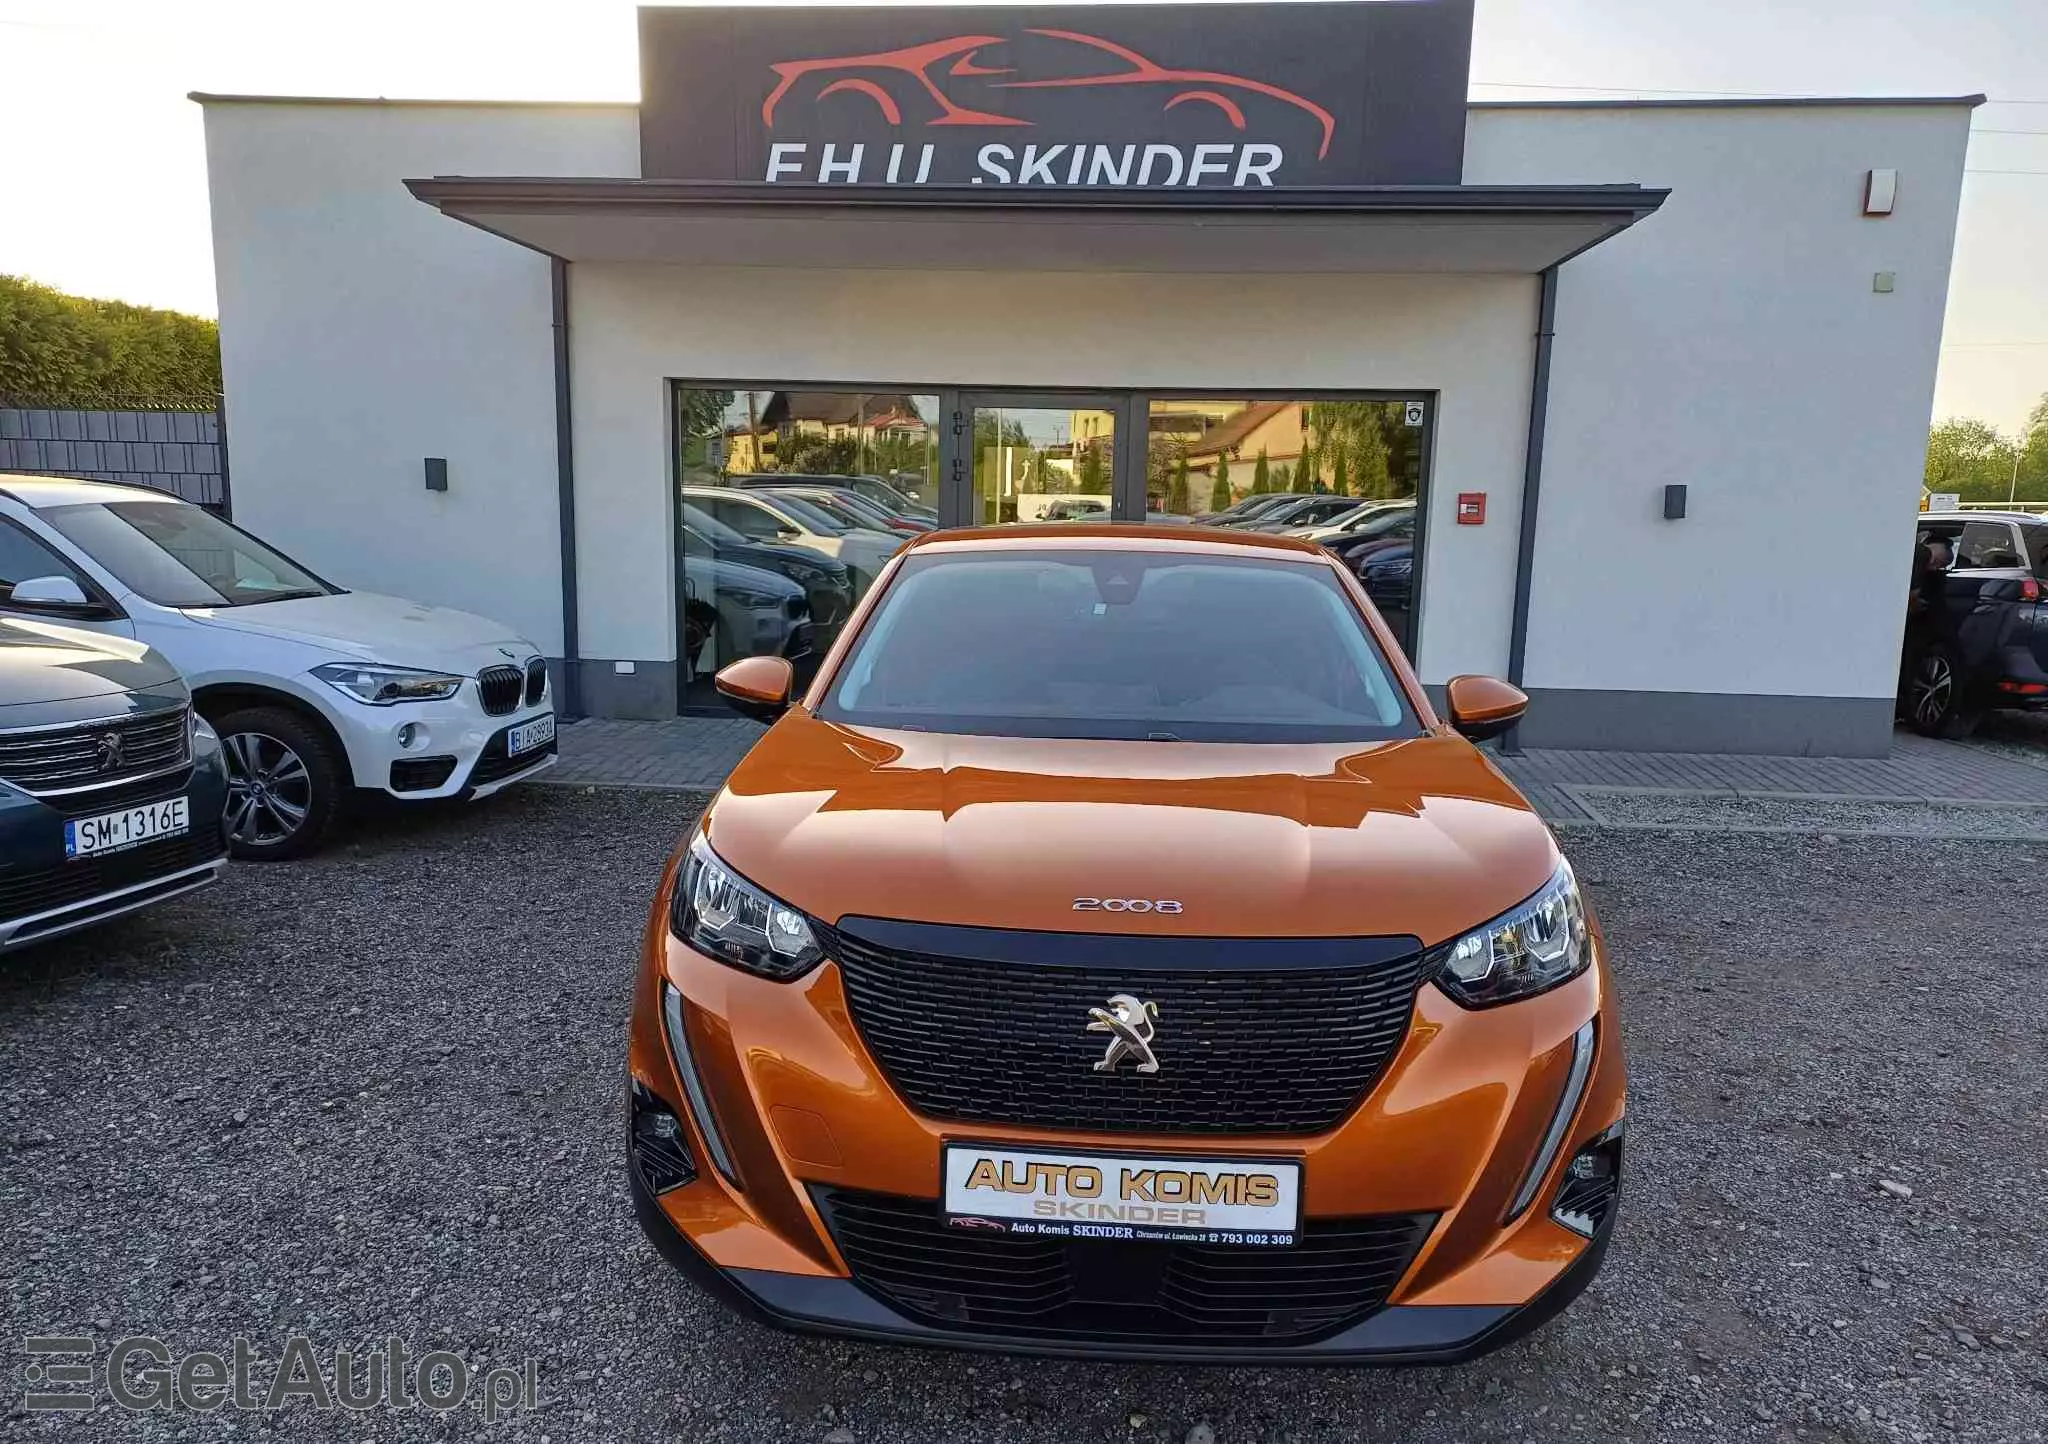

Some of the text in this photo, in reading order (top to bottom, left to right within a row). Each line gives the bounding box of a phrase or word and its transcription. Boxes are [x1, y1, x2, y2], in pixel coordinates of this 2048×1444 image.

[971, 143, 1284, 187] SKINDER
[81, 817, 112, 850] SM
[122, 800, 183, 840] 1316E
[1072, 897, 1184, 914] 2008
[965, 1158, 1279, 1207] AUTO KOMIS
[1033, 1199, 1207, 1226] SKINDER
[1011, 1222, 1036, 1233] Auto
[1038, 1223, 1070, 1235] Komis
[1072, 1224, 1134, 1239] SKINDER
[1222, 1233, 1243, 1244] 793
[1246, 1234, 1268, 1245] 002
[1271, 1234, 1293, 1245] 309
